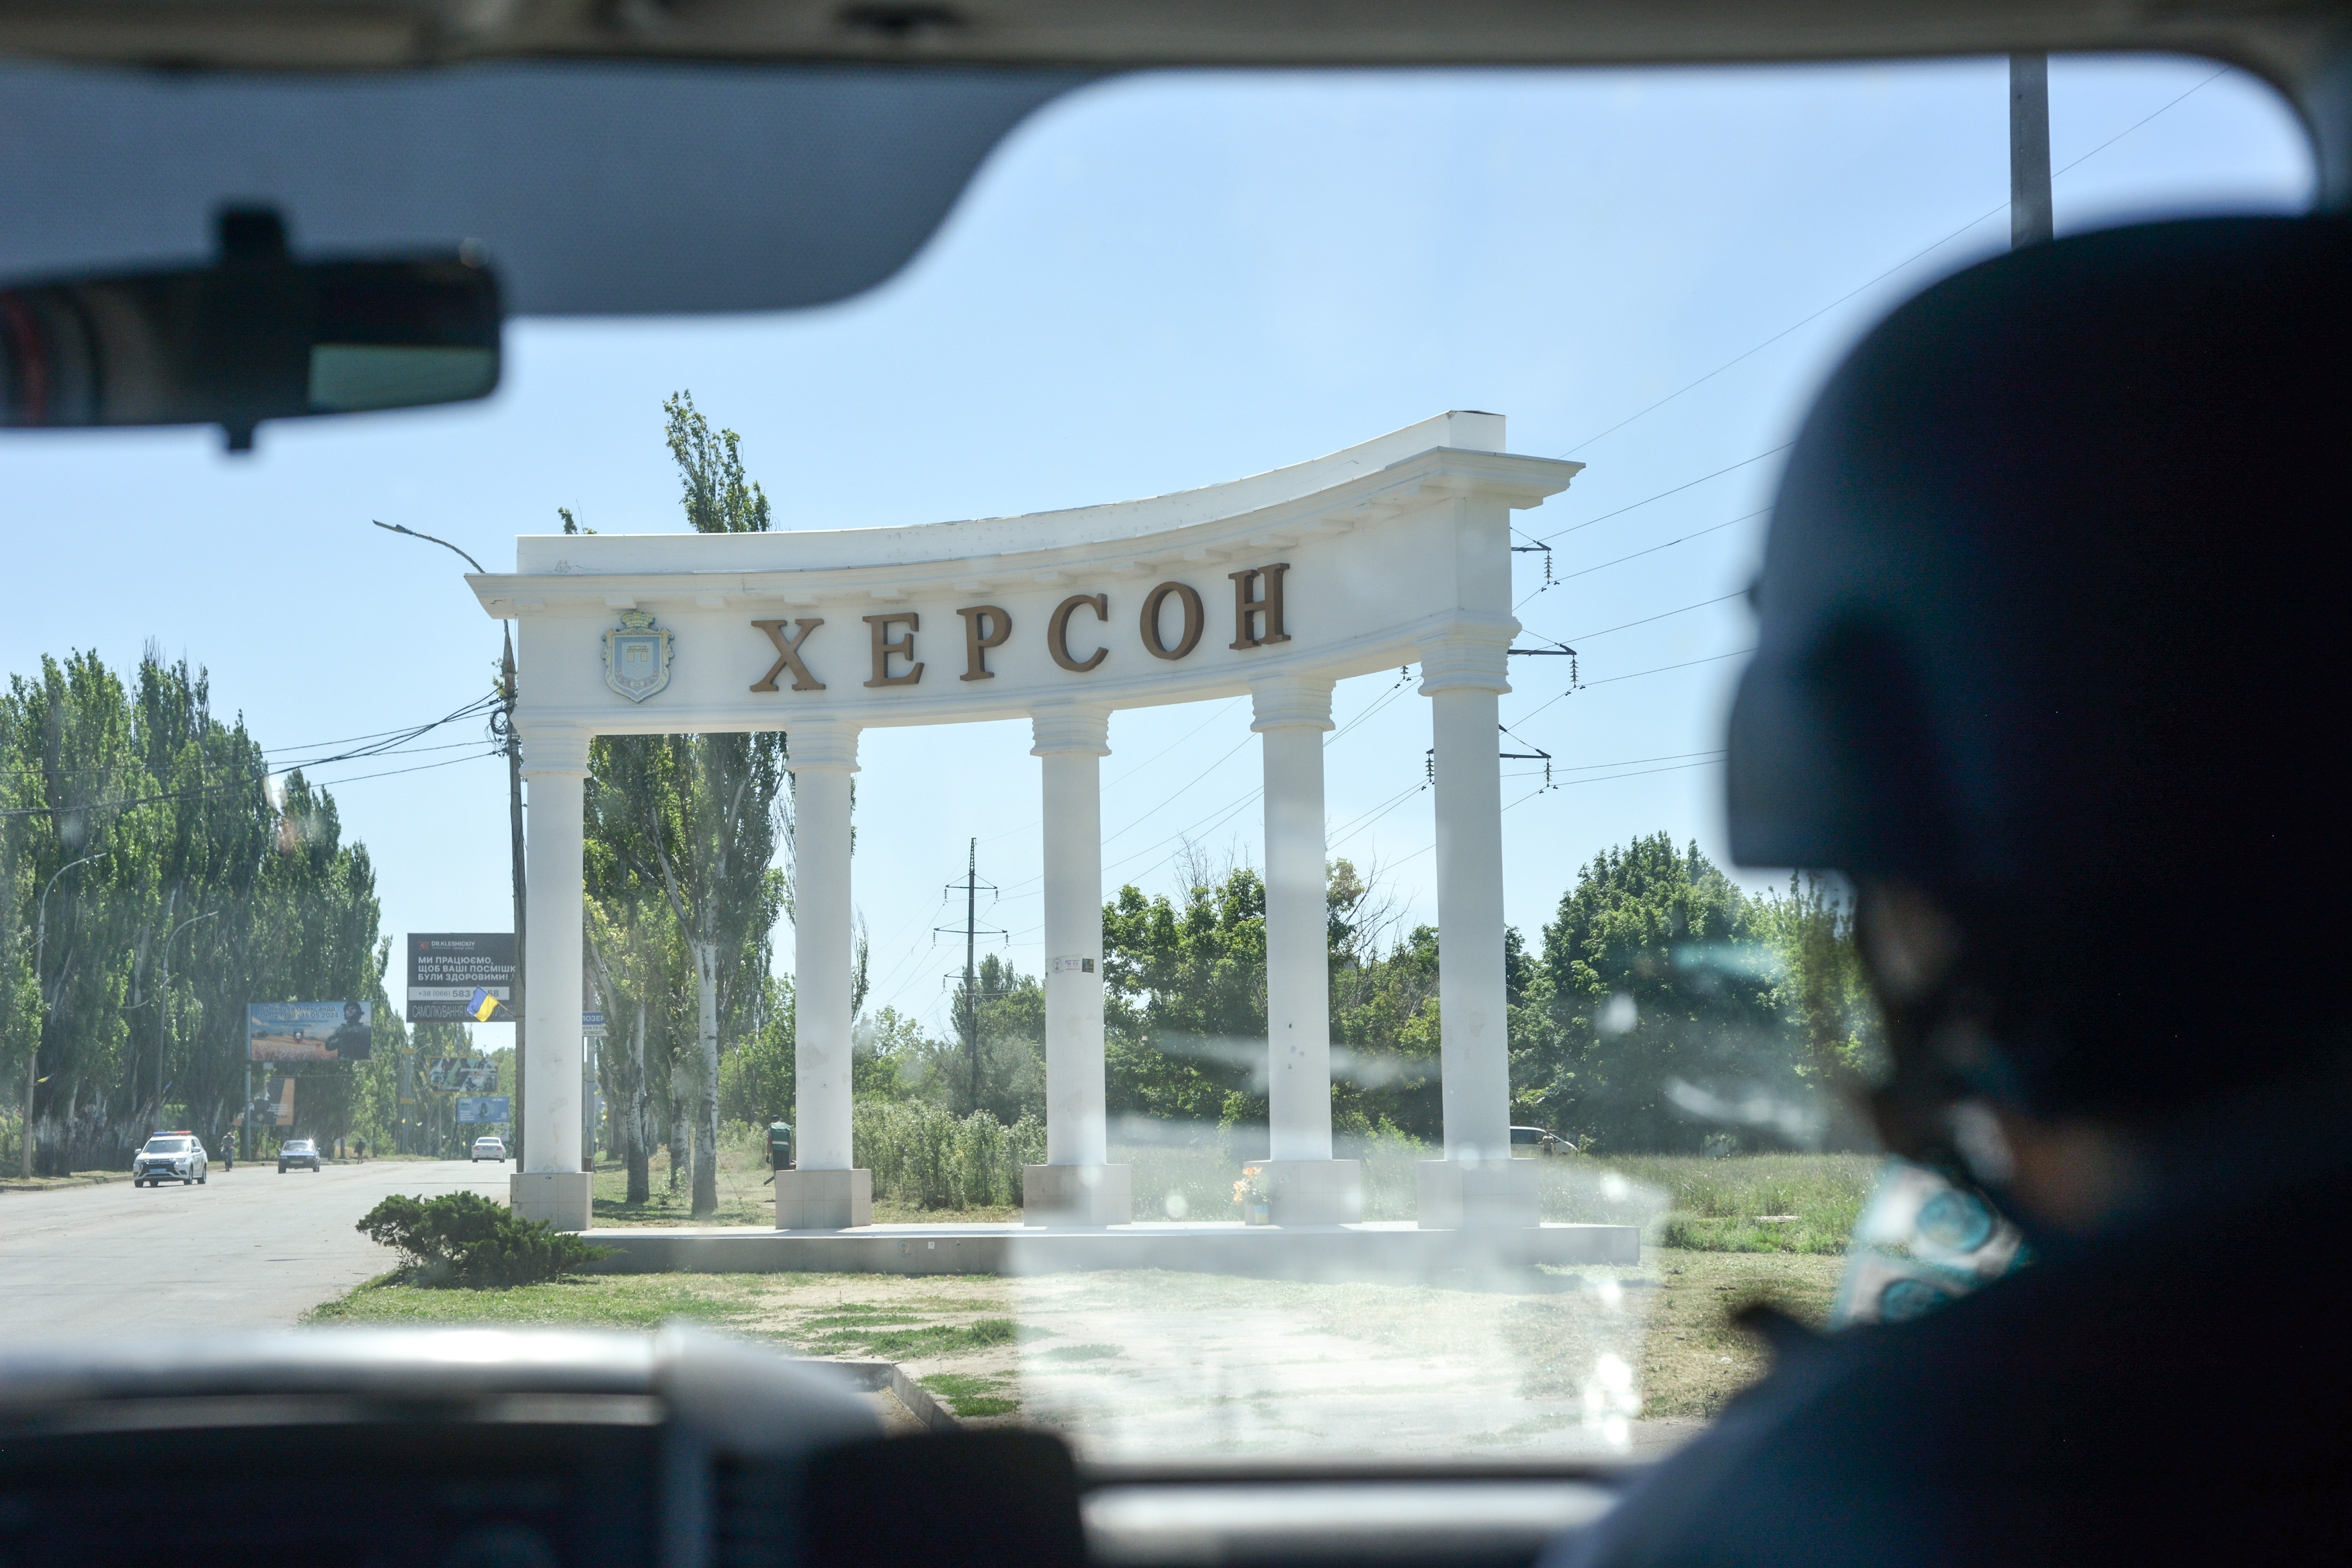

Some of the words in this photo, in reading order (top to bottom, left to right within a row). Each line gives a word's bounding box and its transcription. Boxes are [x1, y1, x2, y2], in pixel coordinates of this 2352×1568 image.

[749, 563, 1291, 693] ХЕРСОН
[435, 957, 493, 965] ПРАЦЮЄМО,
[446, 973, 508, 982] ЗДОРОВИМИ!
[413, 1005, 463, 1018] САМОЛІКУВАННЯ
